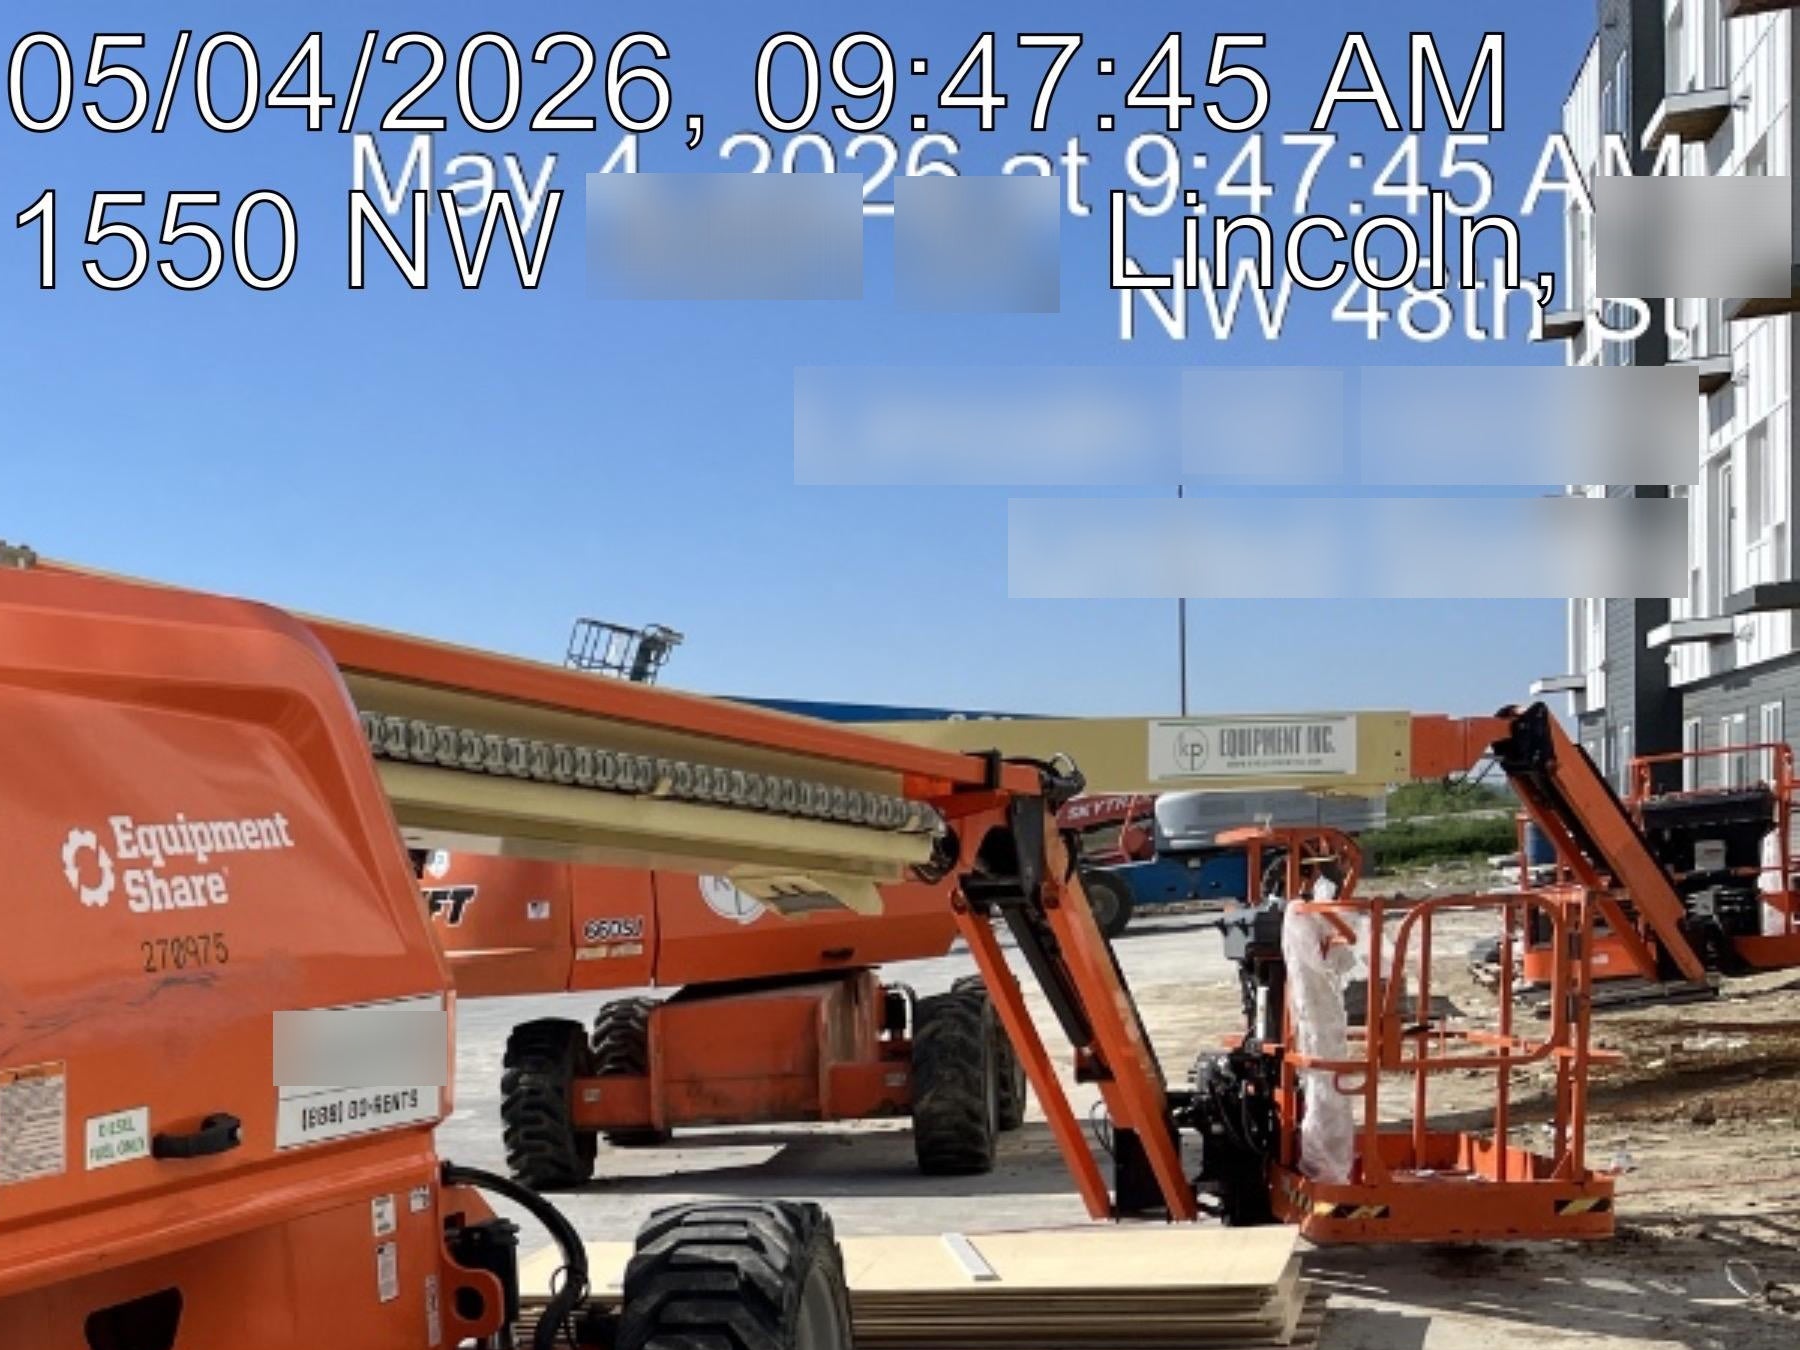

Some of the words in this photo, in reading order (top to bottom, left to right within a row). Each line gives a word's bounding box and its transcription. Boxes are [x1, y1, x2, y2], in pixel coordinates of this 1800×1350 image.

[1220, 725, 1302, 760] EQUIPMENT
[1307, 724, 1336, 753] INC.
[108, 812, 295, 867] Equipment
[122, 868, 229, 913] Share
